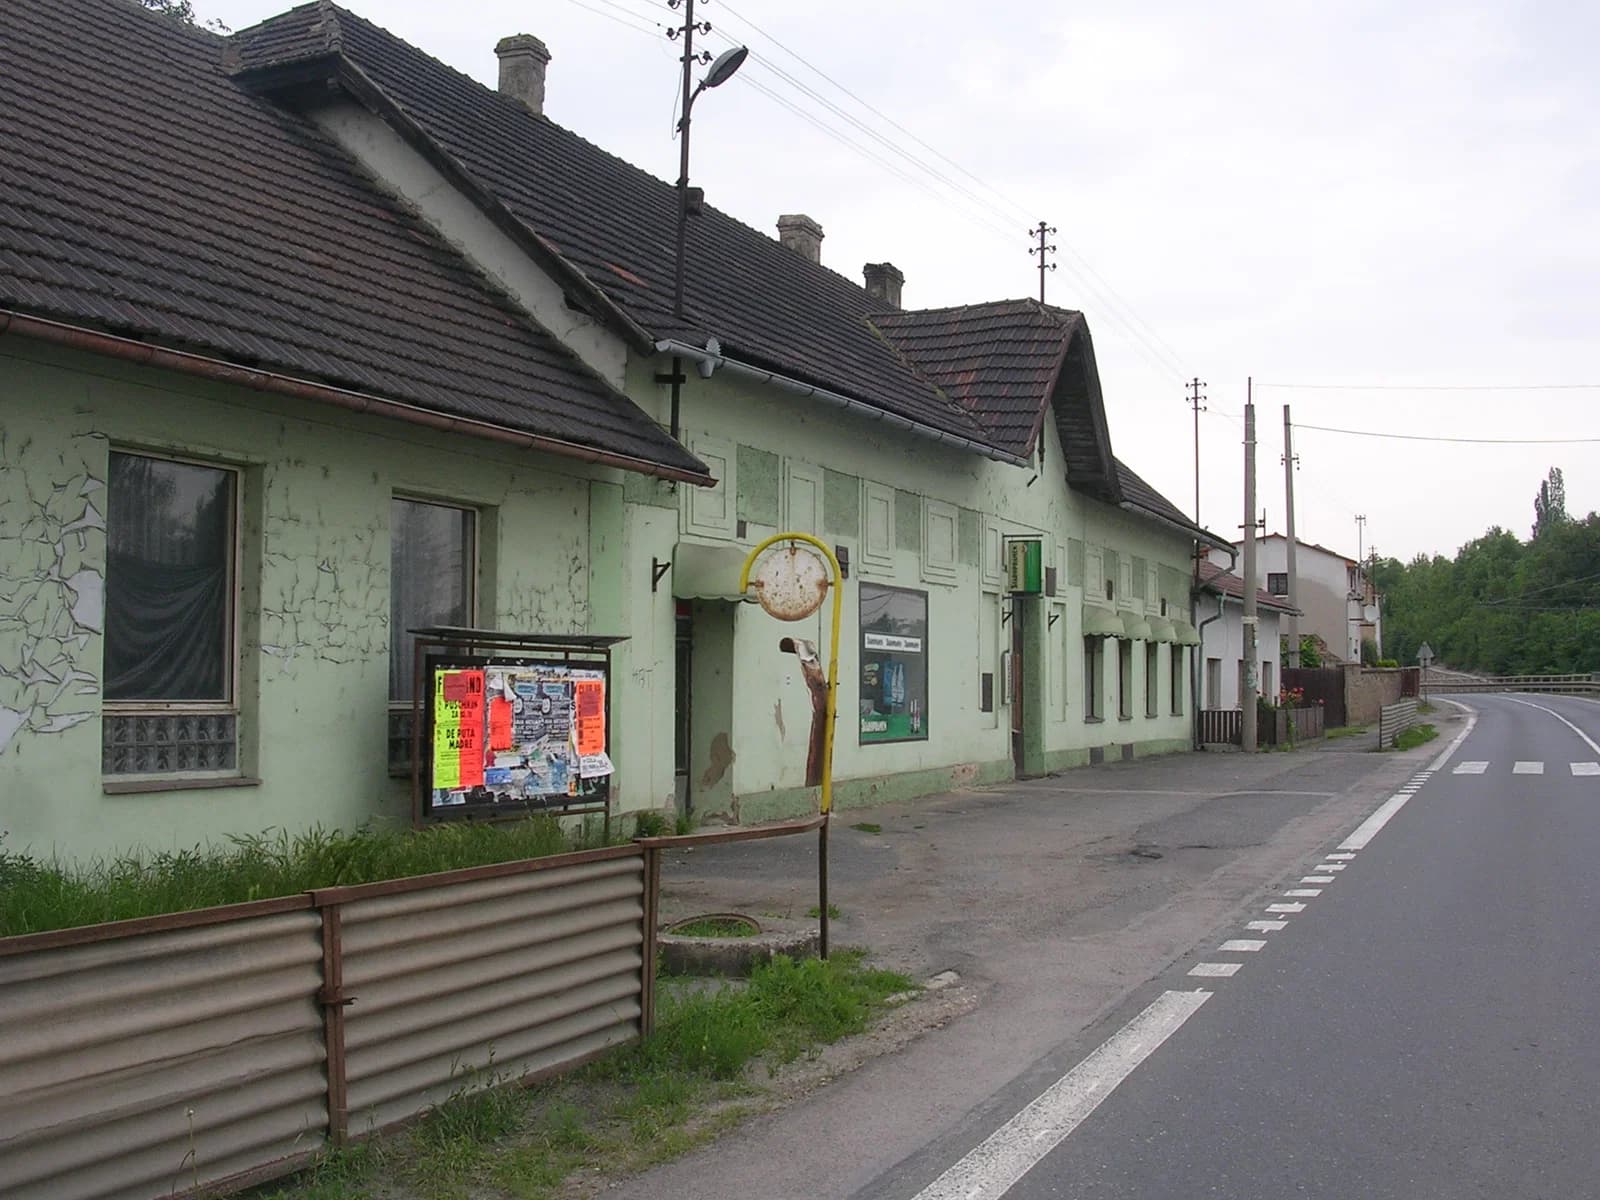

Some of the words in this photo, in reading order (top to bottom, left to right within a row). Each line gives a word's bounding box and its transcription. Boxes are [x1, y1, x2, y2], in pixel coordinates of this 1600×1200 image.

[446, 728, 455, 739] DE
[457, 728, 475, 738] PUTA
[448, 739, 473, 750] MADRE
